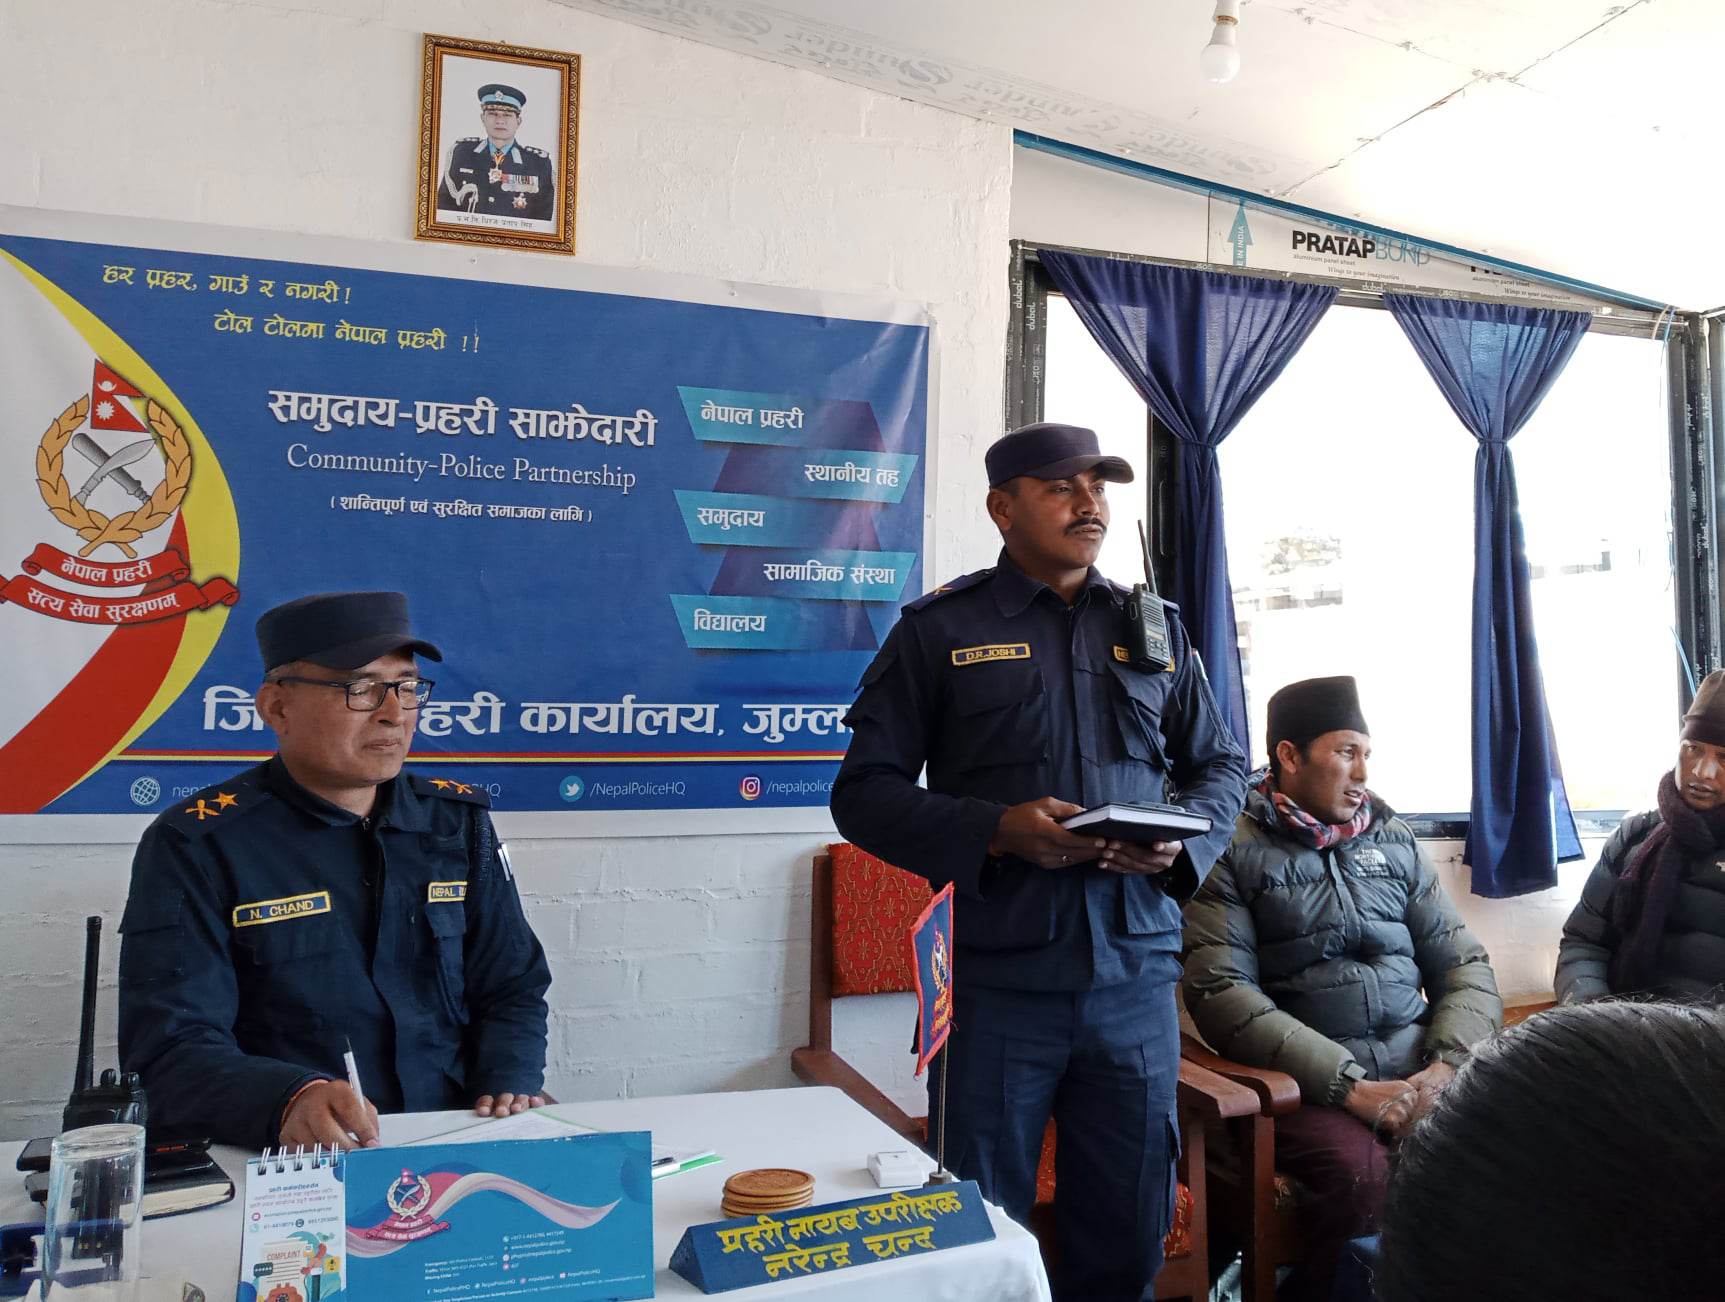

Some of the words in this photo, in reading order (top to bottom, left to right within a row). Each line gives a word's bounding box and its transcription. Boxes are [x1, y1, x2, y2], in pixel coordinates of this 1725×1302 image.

[102, 264, 134, 285] हर
[145, 268, 197, 290] प्रहर,
[260, 280, 275, 298] र
[213, 310, 254, 334] टोल
[264, 312, 325, 340] टोलमा
[336, 318, 388, 345] नेपाल
[397, 324, 447, 351] प्रहरी
[267, 389, 499, 436] समुदाय-प्रहरी
[508, 403, 659, 447] साझेदारी
[700, 400, 754, 425] नेपाल
[760, 406, 804, 429] प्रहरी
[286, 442, 507, 483] Community-Police
[512, 456, 637, 495] Partnership
[804, 461, 871, 484] स्थानीय
[876, 468, 900, 488] तह
[432, 498, 483, 519] सुरक्षित
[487, 502, 546, 521] समाजका
[550, 504, 584, 523] लागि
[697, 506, 765, 531] समुदाय
[61, 558, 107, 583] नेपाल
[112, 559, 153, 584] प्रहरी
[763, 559, 844, 583] सामाजिक
[850, 563, 897, 585] संस्था
[27, 587, 66, 613] सत्य
[69, 594, 100, 618] सेवा
[693, 608, 767, 633] विद्यालय
[415, 691, 506, 738] हरी
[269, 899, 314, 917] CHAND
[716, 1215, 785, 1254] प्रहरी
[786, 1208, 863, 1241] नायब
[863, 1226, 937, 1259] चन्द
